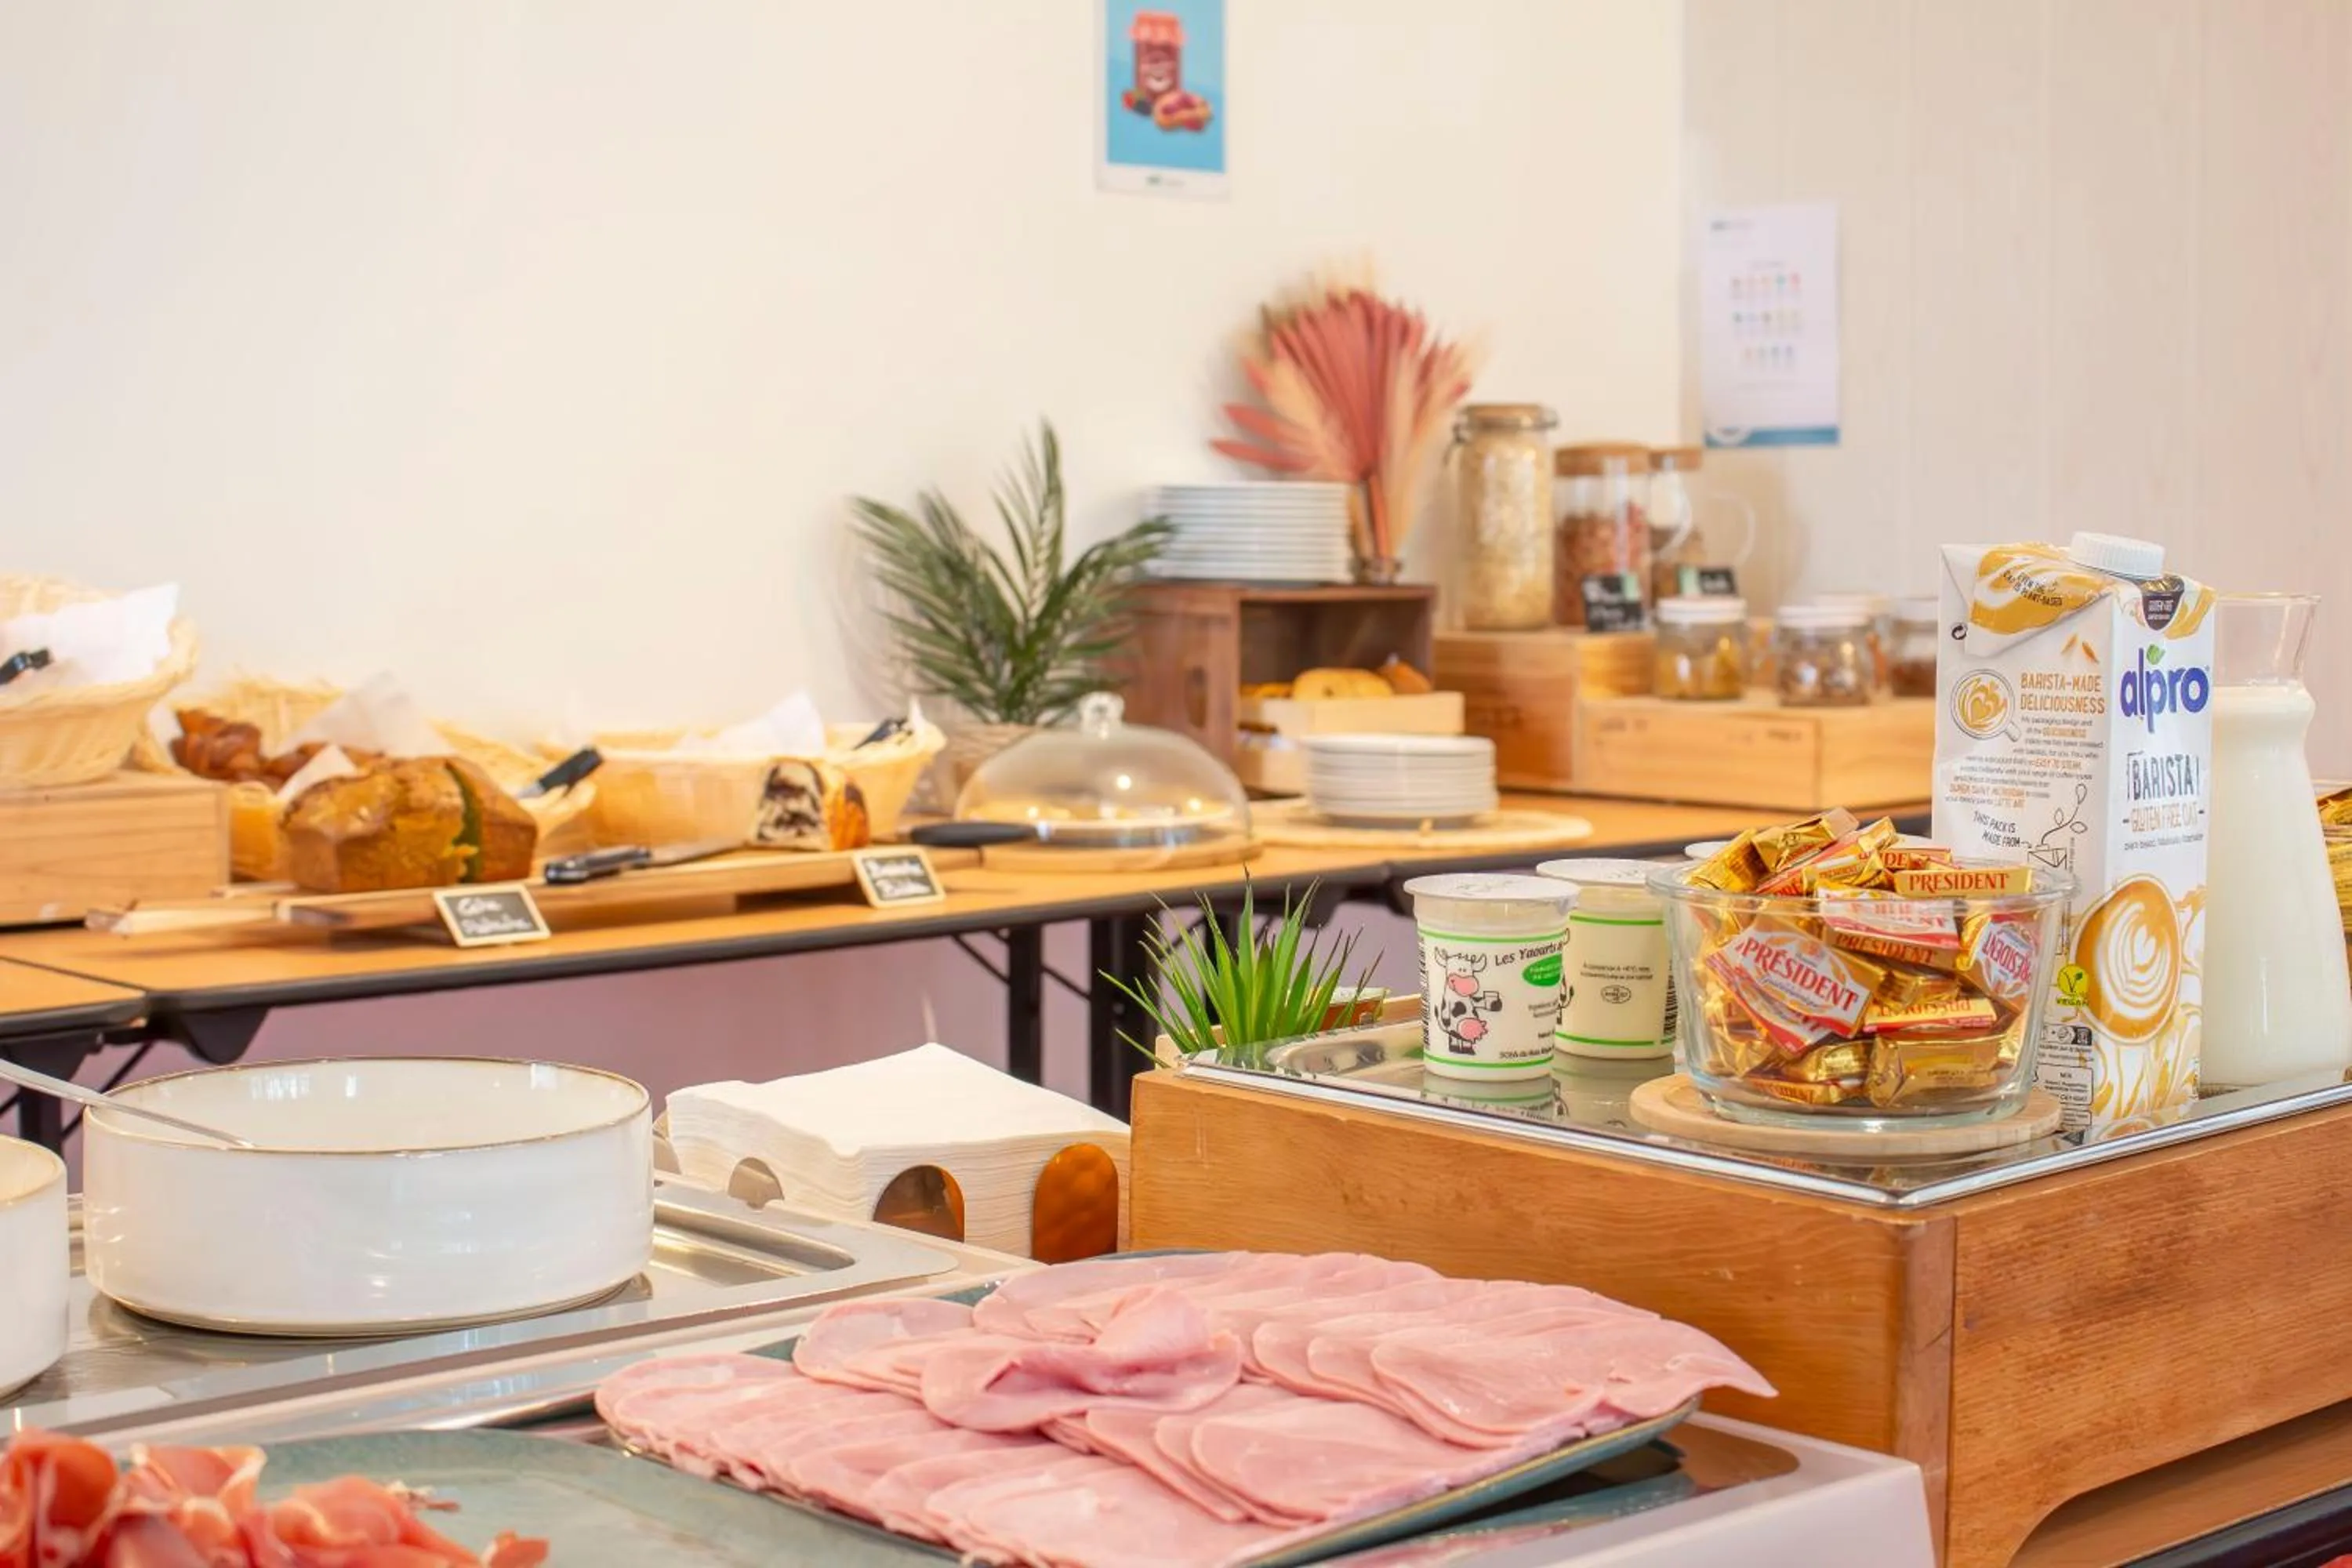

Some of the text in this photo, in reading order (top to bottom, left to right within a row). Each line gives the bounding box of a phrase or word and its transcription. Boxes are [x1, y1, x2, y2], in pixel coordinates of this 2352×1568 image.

[2020, 673, 2101, 692] BARISTA-MADE
[2120, 648, 2209, 734] alpro
[2020, 693, 2105, 714] DELICIOUSNESS
[2132, 753, 2195, 800] BARISTA
[1989, 817, 2007, 832] PACK
[2007, 822, 2016, 833] IS
[2132, 806, 2161, 833] GLUTEN
[2161, 803, 2181, 829] FREE
[1981, 830, 2021, 848] MADE FROM
[1495, 953, 1515, 966] Les
